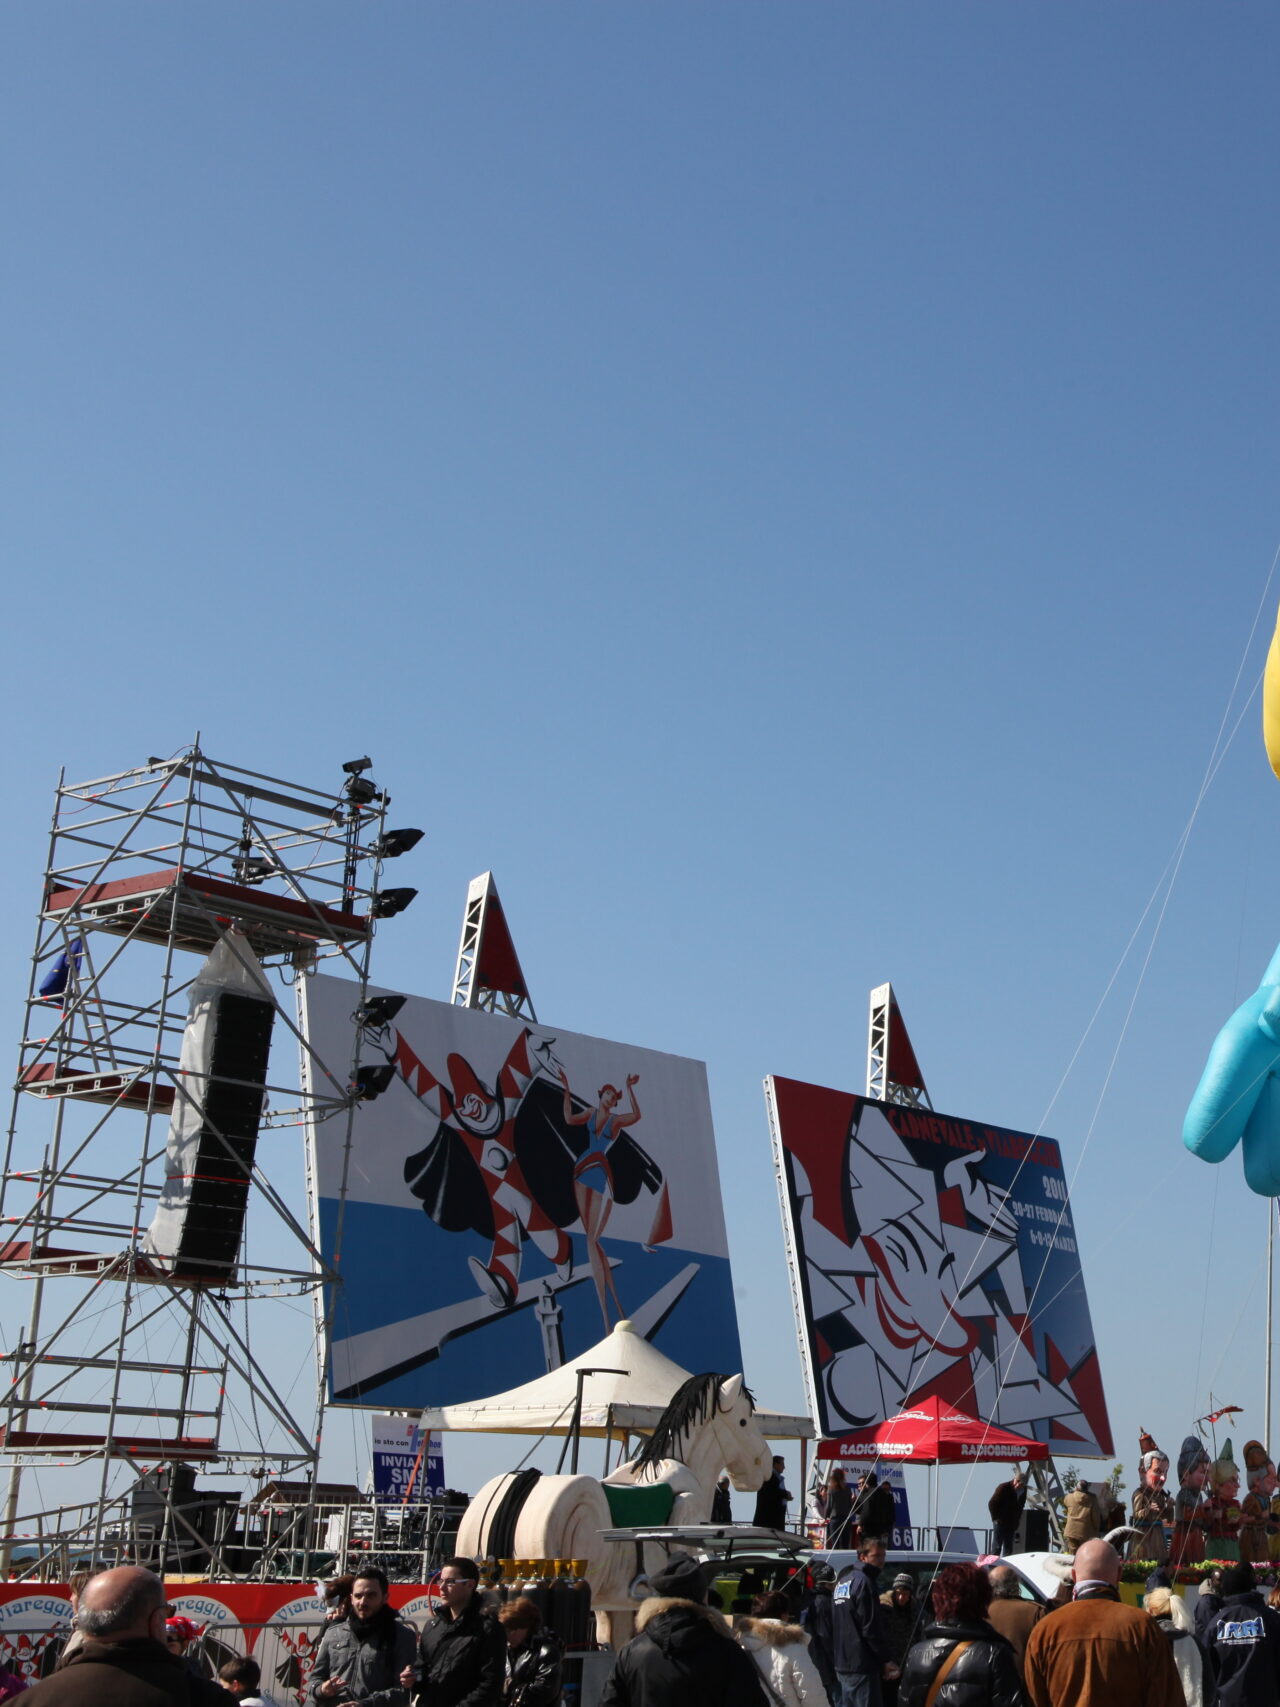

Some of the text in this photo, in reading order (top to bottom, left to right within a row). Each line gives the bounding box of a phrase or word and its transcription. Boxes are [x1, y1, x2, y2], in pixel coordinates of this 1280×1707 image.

[1042, 1175, 1067, 1201] 2011
[840, 1443, 914, 1456] RADIOBRUNO
[961, 1444, 1029, 1457] RADIOBRUNO
[381, 1455, 416, 1468] INVIA
[391, 1467, 428, 1484] SMS
